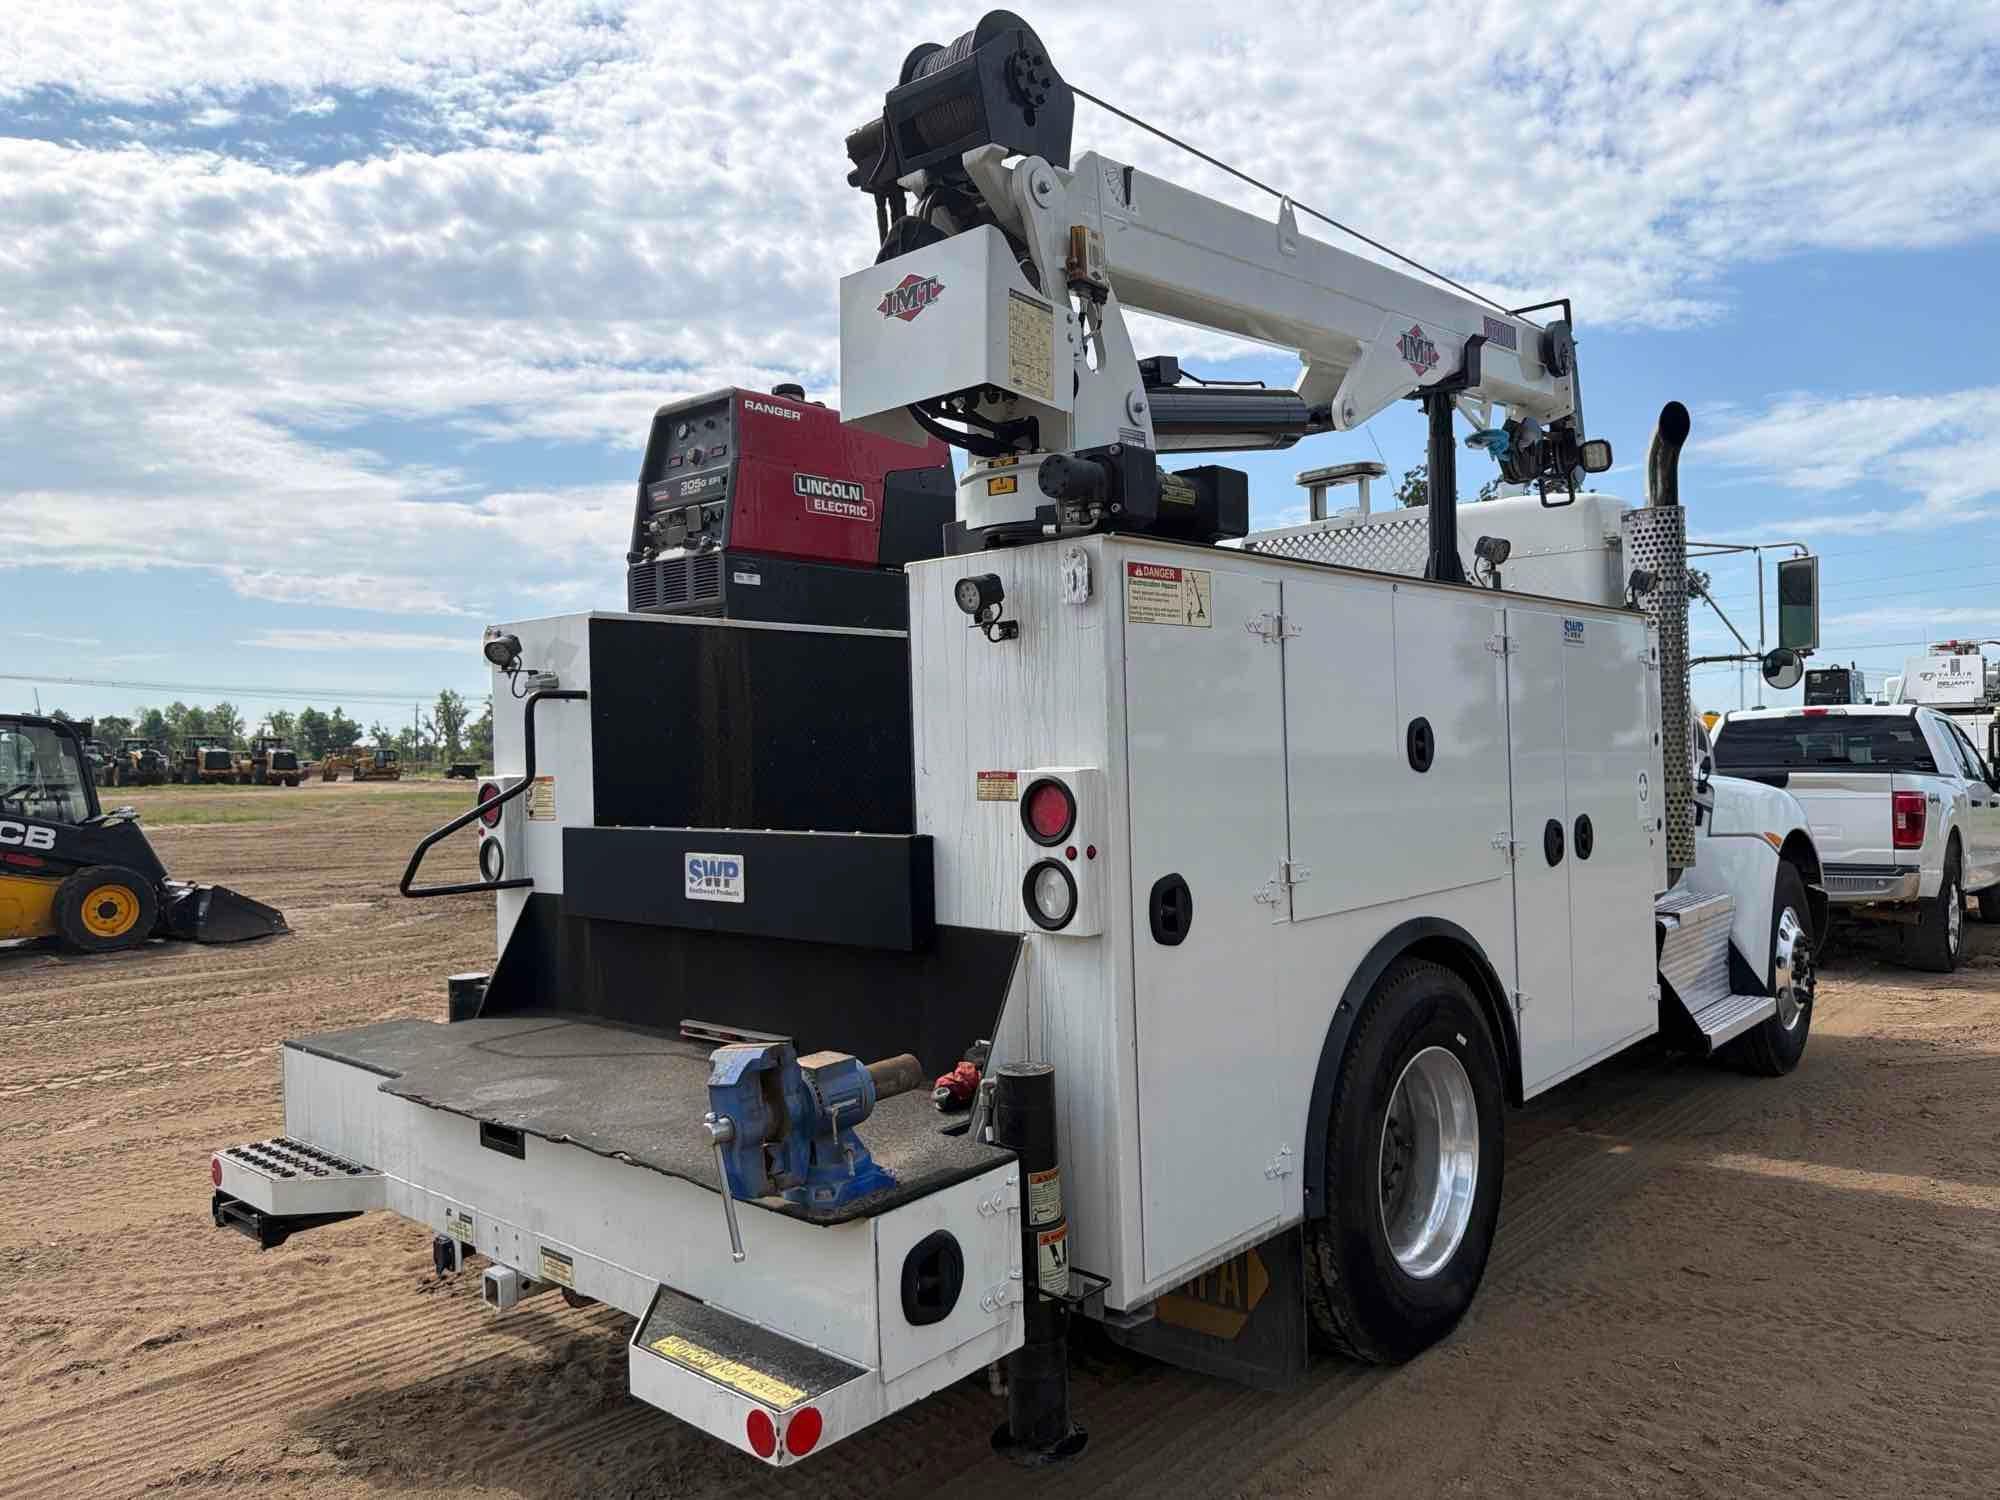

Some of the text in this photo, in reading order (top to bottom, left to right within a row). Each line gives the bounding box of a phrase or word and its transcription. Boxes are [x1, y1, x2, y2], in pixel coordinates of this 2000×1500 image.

[884, 275, 938, 319] IMT
[1401, 334, 1436, 367] IMT
[744, 400, 801, 421] RANGER
[798, 477, 861, 501] LINCOLN
[813, 499, 868, 517] ELECTRIC
[1143, 566, 1175, 580] DANGER
[688, 858, 739, 887] SWP
